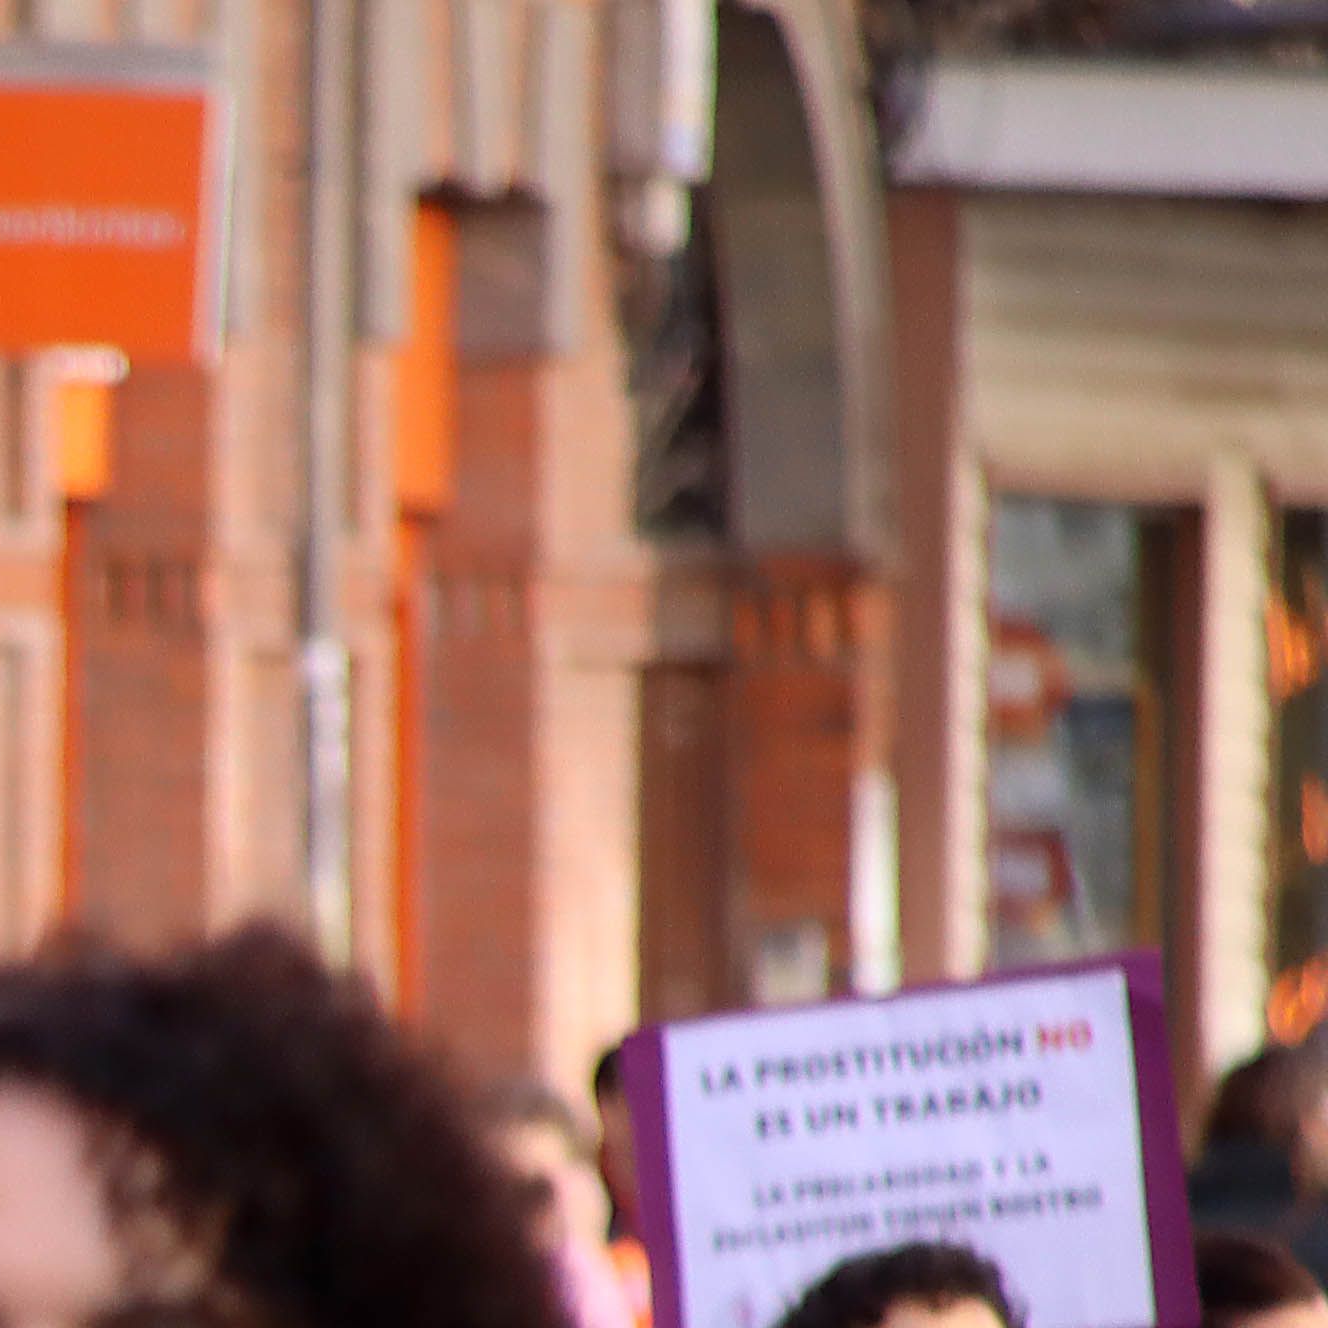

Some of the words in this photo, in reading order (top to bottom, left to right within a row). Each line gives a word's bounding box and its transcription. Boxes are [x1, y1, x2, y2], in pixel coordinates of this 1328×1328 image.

[700, 1062, 742, 1096] LA
[753, 1023, 1025, 1088] PROSTITUCIÓN
[1035, 1018, 1093, 1055] NO
[754, 1108, 793, 1140] ES
[803, 1101, 859, 1133] UN
[872, 1078, 1042, 1124] TRABAJO
